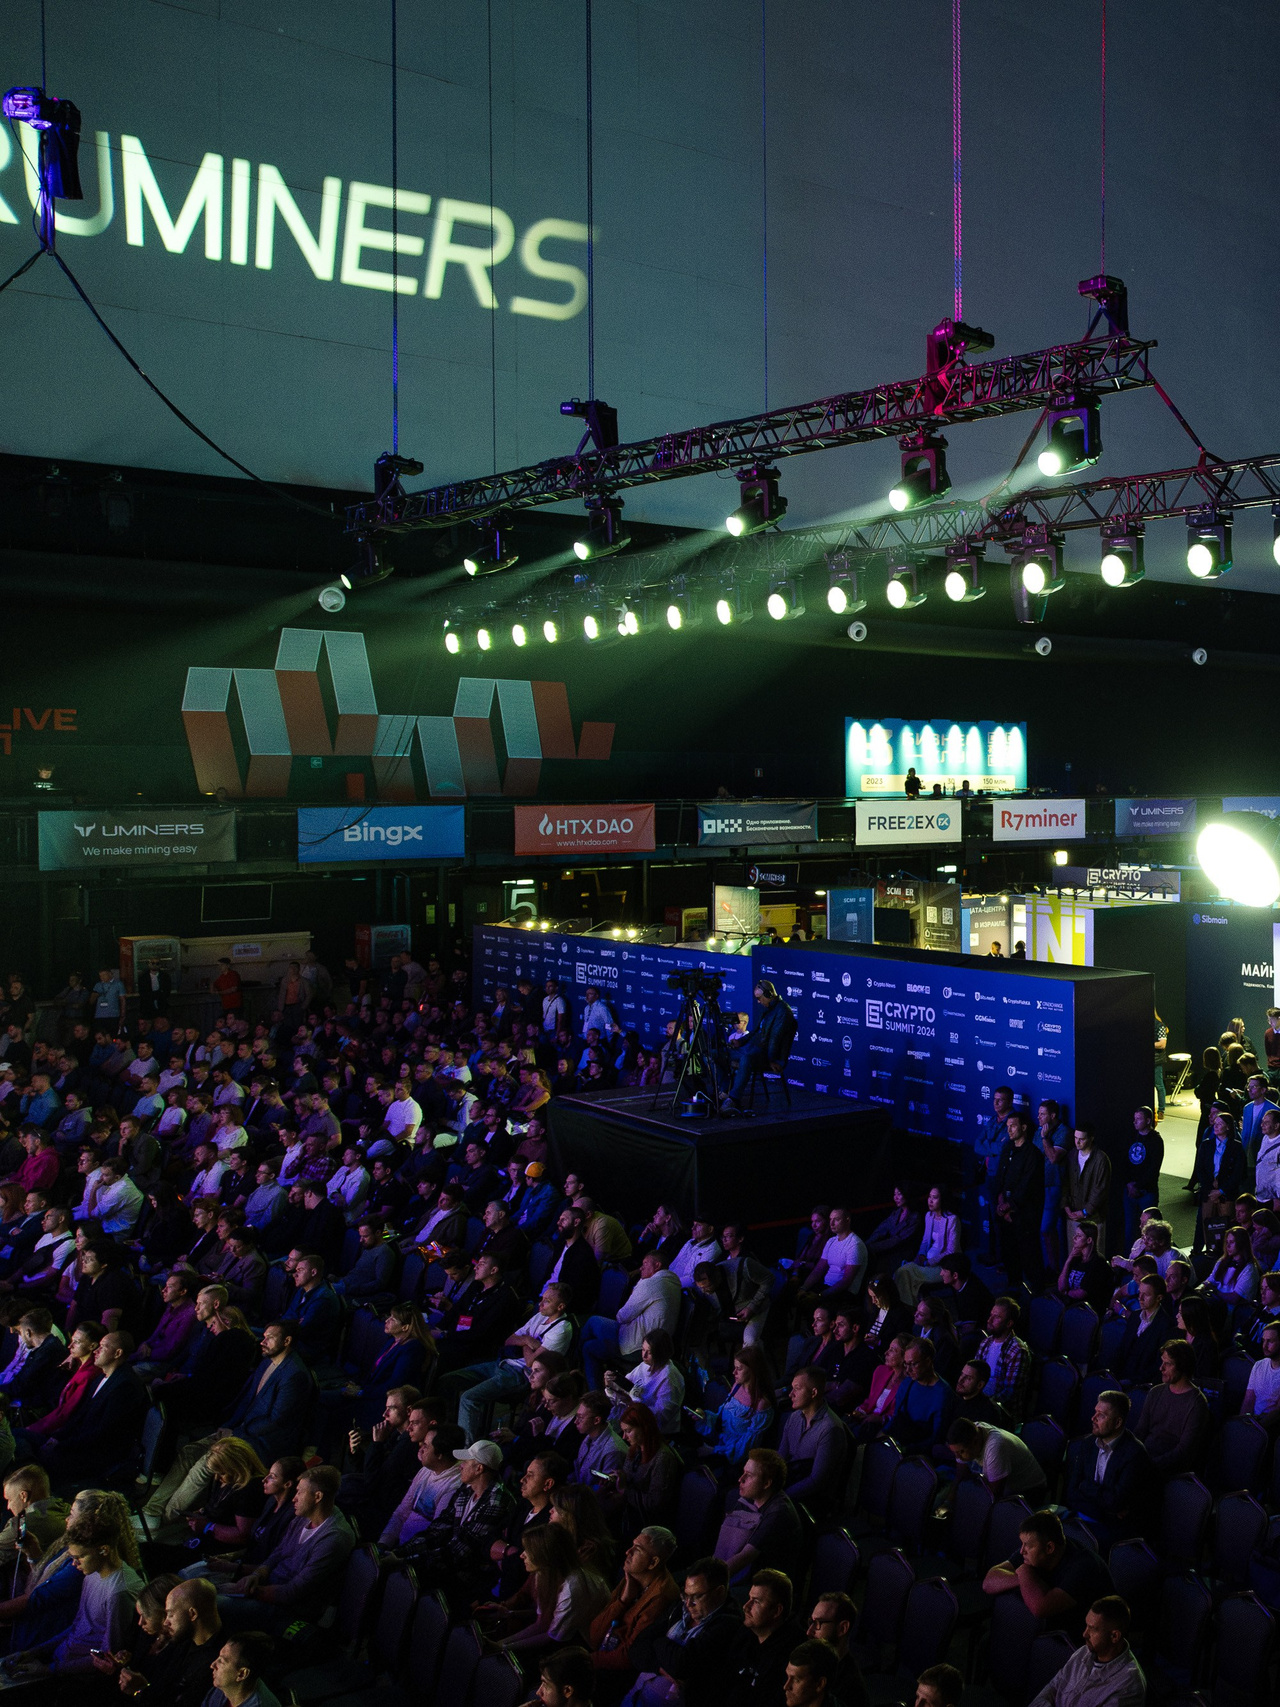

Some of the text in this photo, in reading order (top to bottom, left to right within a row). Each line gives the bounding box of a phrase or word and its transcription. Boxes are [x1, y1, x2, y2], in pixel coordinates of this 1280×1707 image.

[866, 777, 883, 785] 2023
[983, 777, 993, 785] 150
[1141, 807, 1184, 815] UMINERS
[556, 818, 634, 835] HTX DAO
[703, 819, 742, 834] OKX
[868, 814, 935, 831] FREE2EX
[1000, 810, 1078, 831] R7miner
[102, 823, 205, 837] UMINERS
[556, 838, 618, 847] www.htxdao.com
[83, 844, 198, 856] We make mining easy
[1102, 869, 1141, 881] CRYPTO
[510, 888, 538, 922] 5
[1202, 915, 1228, 924] Sibmain
[587, 964, 618, 979] CRYPTO
[588, 978, 618, 989] SUMMIT 2024
[884, 1001, 936, 1023] CRYPTO
[885, 1020, 936, 1038] SUMMIT 2024
